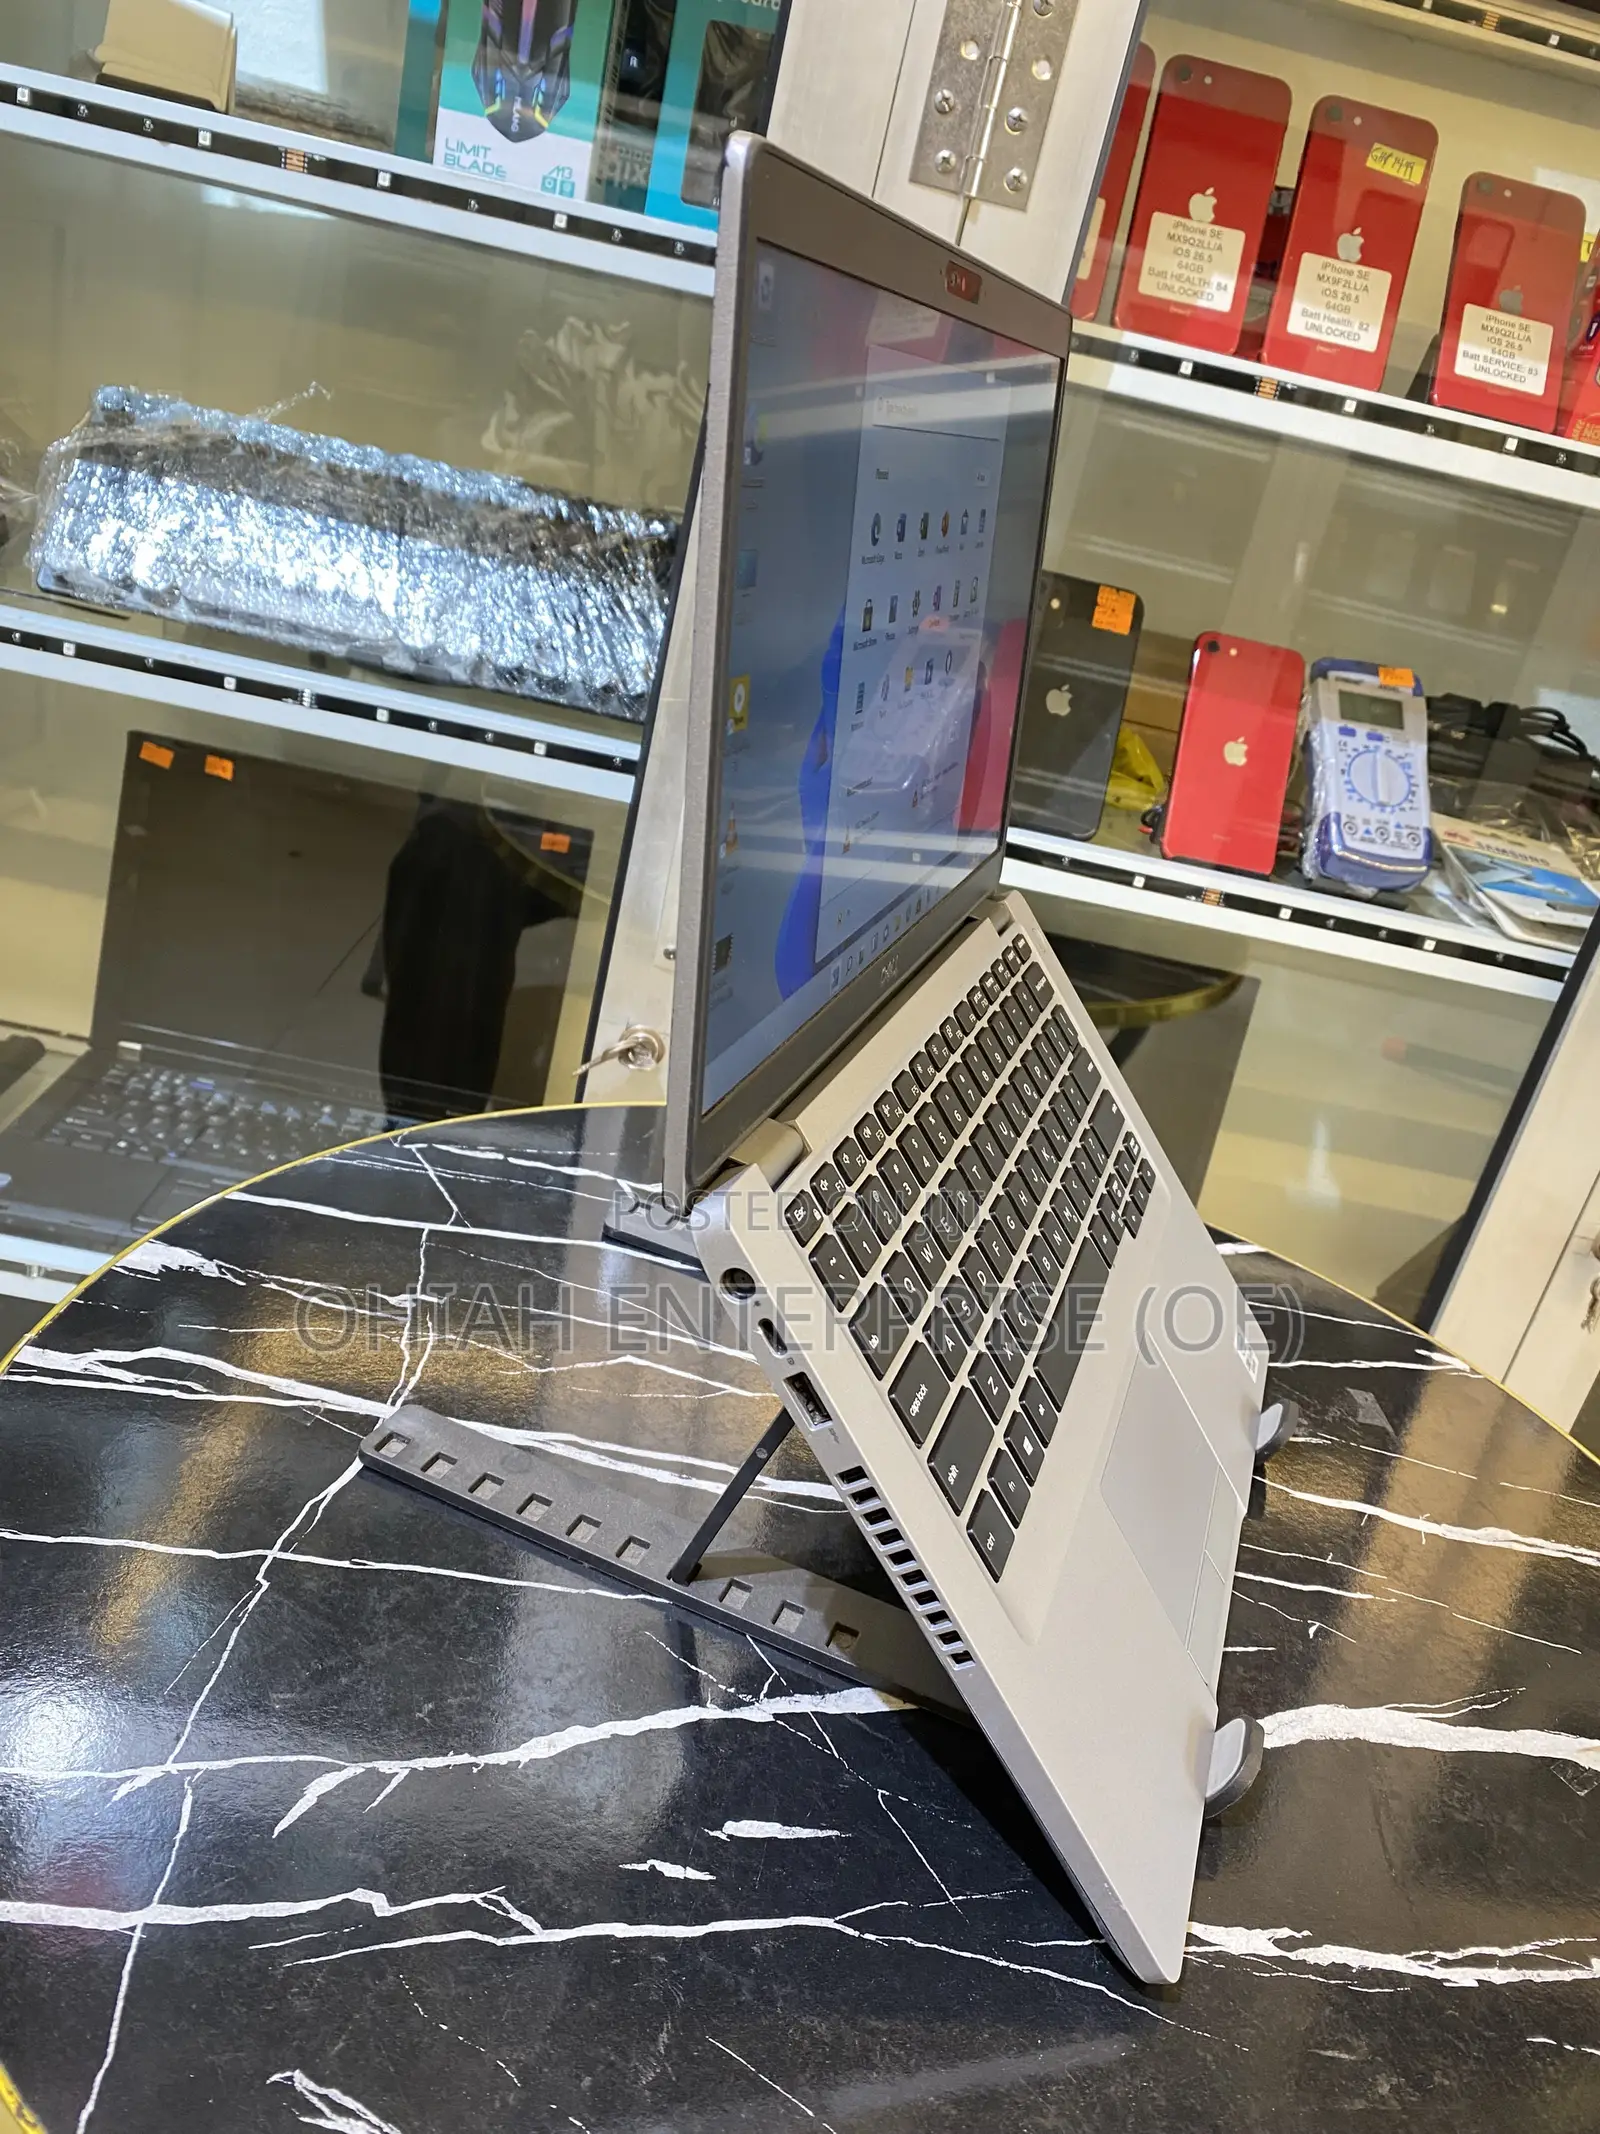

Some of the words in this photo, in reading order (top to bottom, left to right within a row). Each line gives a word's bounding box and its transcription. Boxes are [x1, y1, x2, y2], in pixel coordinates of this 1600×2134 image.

[445, 137, 491, 159] LIMIT
[443, 153, 507, 178] BLADE
[1172, 220, 1207, 236] iPhone
[1209, 229, 1223, 239] SE
[1173, 247, 1190, 258] iOS
[1177, 260, 1204, 273] 64GB
[1321, 260, 1354, 277] iPhone
[1356, 270, 1370, 280] SE
[1148, 266, 1168, 279] Batt
[1215, 282, 1228, 292] 84
[1156, 282, 1214, 301] UNLOCKED
[1321, 287, 1338, 298] iOS
[1301, 307, 1321, 320] Batt
[1325, 301, 1351, 314] 64GB
[1486, 314, 1516, 328] iPhone
[1518, 322, 1531, 332] SE
[1305, 321, 1361, 342] UNLOCKED
[1487, 336, 1502, 346] iOS
[1462, 349, 1480, 361] Batt
[1491, 347, 1515, 360] 64GB
[1473, 363, 1526, 383] UNLOCKED
[1475, 841, 1550, 866] SAMSUNG
[1006, 1035, 1014, 1046] 0
[941, 1047, 949, 1057] F7
[994, 1053, 1001, 1063] 9
[927, 1066, 935, 1076] F6
[981, 1071, 989, 1082] 8
[1034, 1066, 1041, 1078] P
[911, 1086, 919, 1096] F5
[968, 1089, 975, 1101] 7
[1023, 1083, 1031, 1095] O
[894, 1107, 902, 1117] F4
[954, 1110, 961, 1121] 6
[999, 1121, 1008, 1135] U
[1052, 1129, 1060, 1140] L
[875, 1130, 884, 1141] F3
[939, 1132, 947, 1144] 5
[986, 1142, 994, 1156] Y
[1041, 1147, 1050, 1161] K
[856, 1155, 865, 1166] F2
[922, 1156, 931, 1168] 4
[972, 1165, 981, 1179] T
[1031, 1168, 1038, 1182] J
[835, 1181, 844, 1192] F1
[903, 1182, 912, 1195] 3
[957, 1191, 967, 1206] R
[1018, 1190, 1028, 1206] H
[794, 1207, 806, 1221] Esc
[884, 1211, 892, 1224] 2
[1063, 1206, 1072, 1222] M
[941, 1216, 951, 1233] E
[1006, 1215, 1015, 1229] G
[1052, 1229, 1062, 1245] N
[862, 1241, 871, 1253] 1
[921, 1243, 934, 1263] W
[992, 1241, 1000, 1257] F
[1042, 1256, 1051, 1271] B
[904, 1277, 915, 1293] Q
[977, 1270, 987, 1286] D
[1030, 1281, 1039, 1296] V
[961, 1300, 971, 1316] S
[1018, 1312, 1027, 1327] C
[868, 1334, 880, 1349] tab
[945, 1334, 955, 1351] A
[1003, 1342, 1014, 1361] X
[987, 1376, 999, 1395] Z
[910, 1397, 920, 1416] caps
[916, 1383, 928, 1402] lock
[947, 1464, 959, 1485] shift
[1007, 1480, 1016, 1493] fn
[986, 1532, 996, 1551] ctrl
